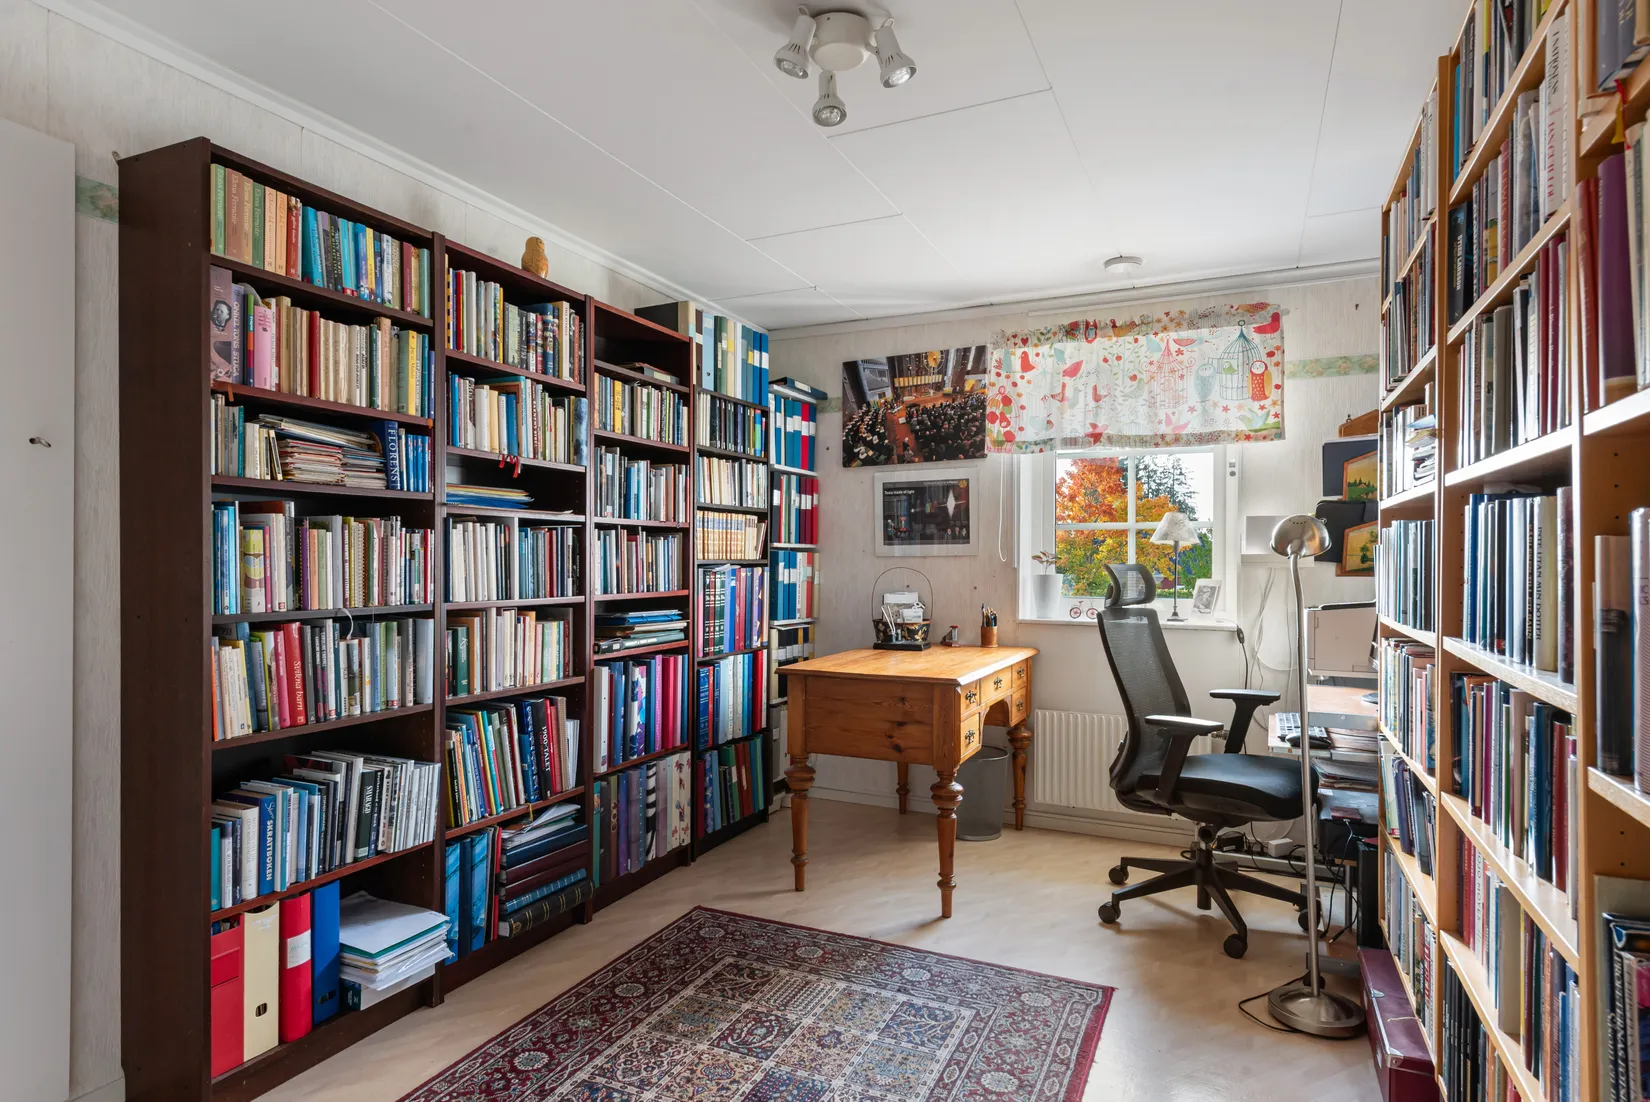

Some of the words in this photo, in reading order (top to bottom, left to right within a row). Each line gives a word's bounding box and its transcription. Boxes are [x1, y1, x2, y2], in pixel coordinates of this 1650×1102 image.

[233, 301, 241, 327] ONKEL
[233, 328, 241, 349] TOMS
[388, 429, 398, 481] FLORENS
[293, 660, 302, 689] Svikna
[295, 691, 304, 711] barn
[542, 725, 551, 772] 1900-TALET
[364, 785, 373, 814] SMARAGD
[374, 771, 382, 802] Brotherhood
[264, 801, 276, 819] Stora
[266, 819, 274, 881] SKRATTBOKEN
[1614, 956, 1625, 1058] PROFETERNAS
